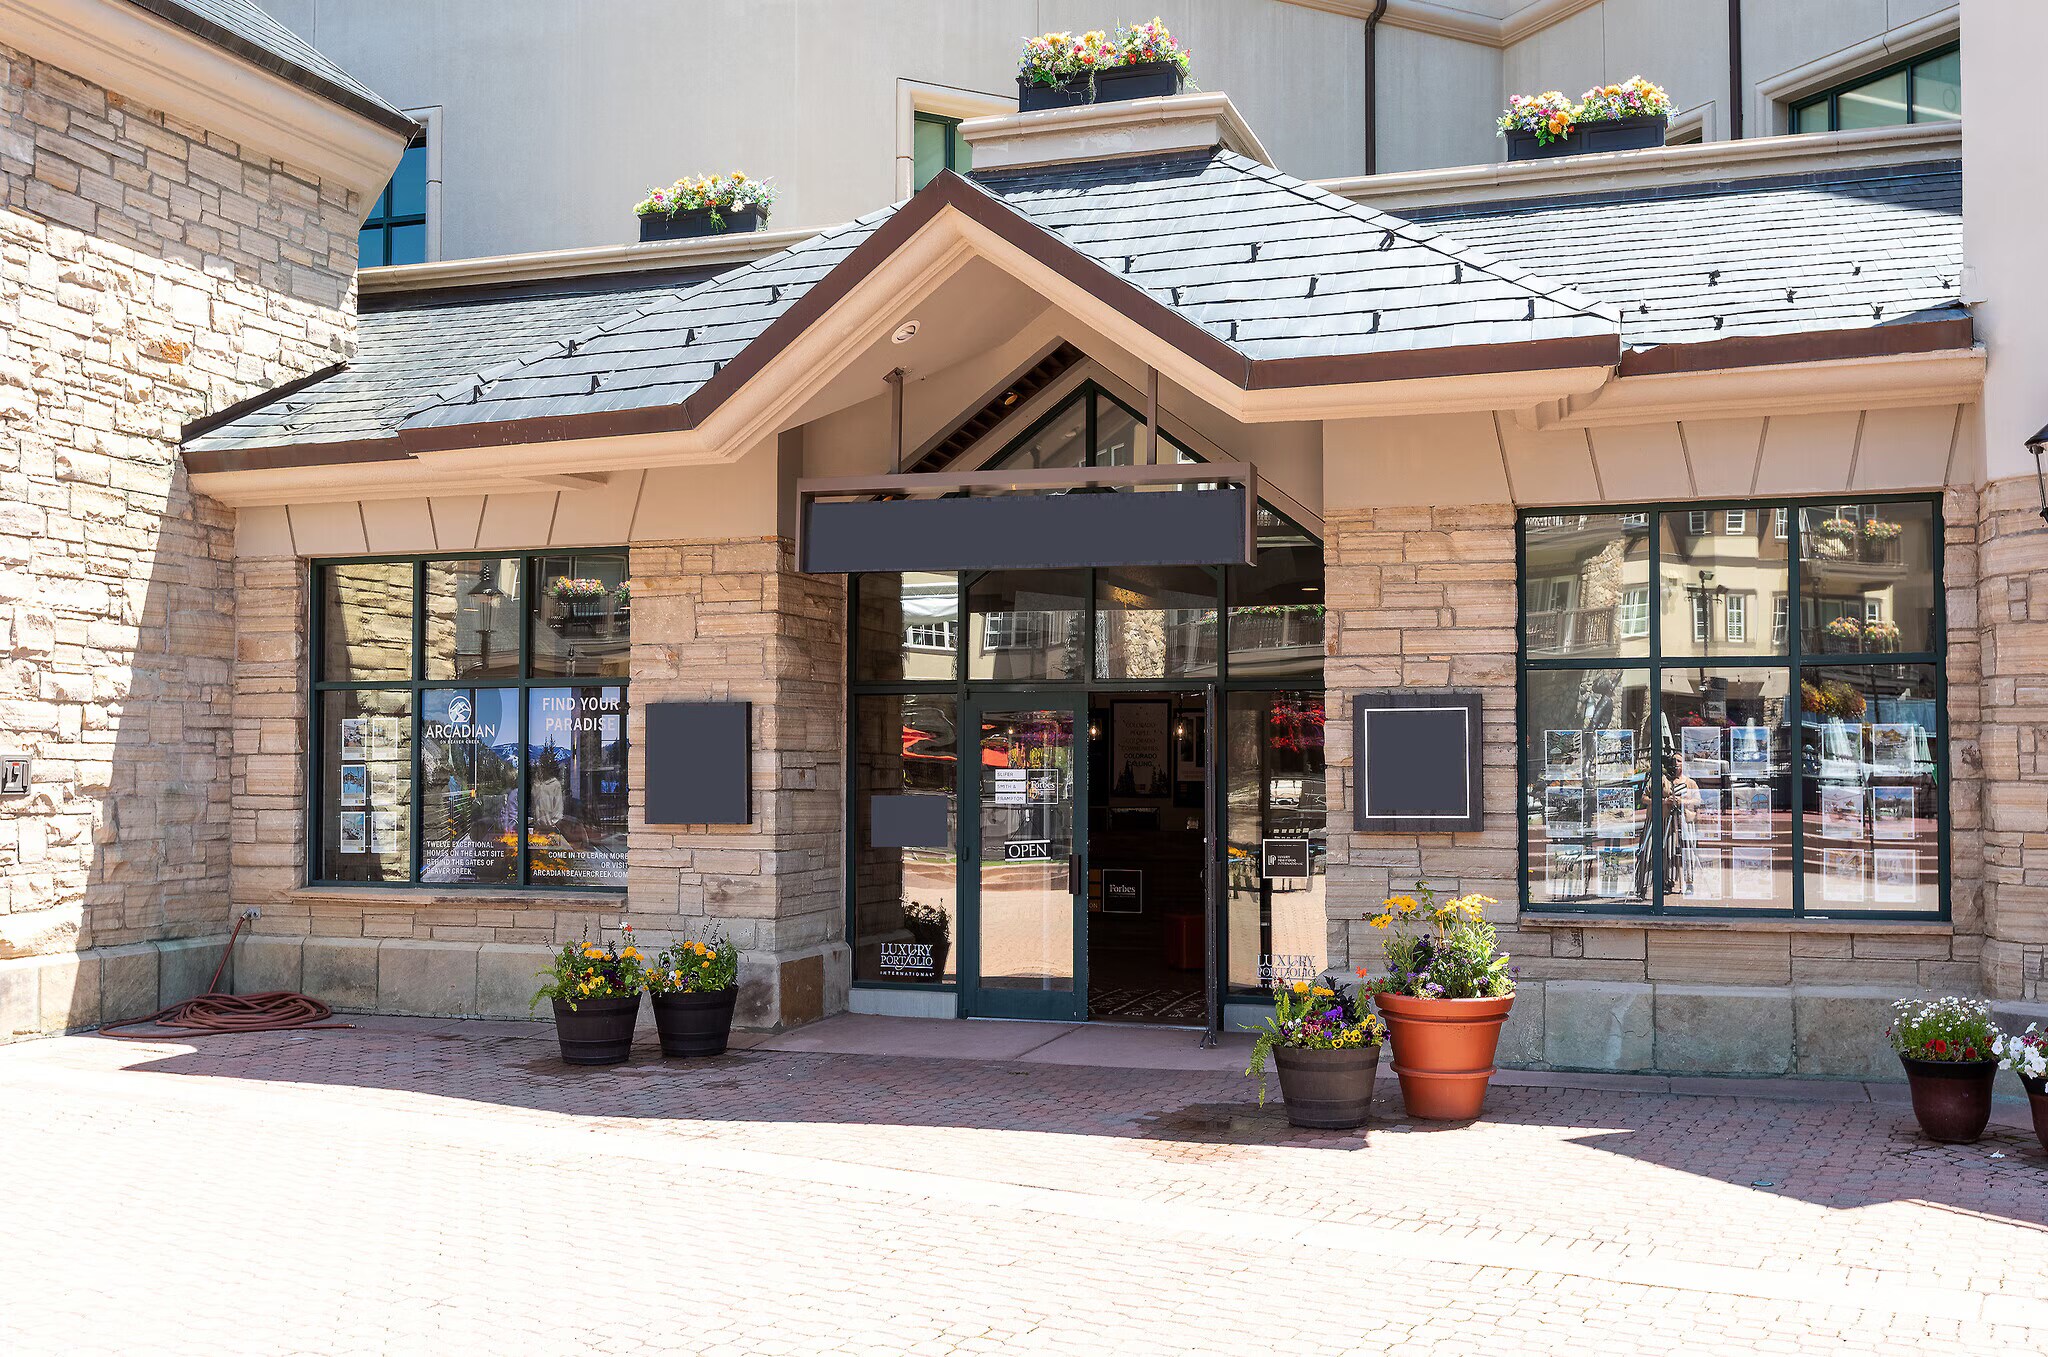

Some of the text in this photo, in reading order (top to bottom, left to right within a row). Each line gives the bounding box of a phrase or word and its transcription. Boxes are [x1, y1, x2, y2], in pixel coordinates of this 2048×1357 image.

[543, 697, 619, 711] FIND YOUR
[545, 717, 616, 731] PARADISE
[425, 724, 496, 738] ARCADIAN
[452, 840, 494, 848] EXCEPTIONAL
[474, 850, 489, 858] LAST
[491, 850, 505, 858] SITE
[548, 851, 567, 859] COME
[1008, 843, 1047, 858] OPEN
[486, 859, 495, 867] OF
[427, 867, 450, 875] BEAVER
[1109, 884, 1136, 893] Forbes
[880, 943, 934, 956] LUXURY
[880, 955, 934, 967] PORTFOLIO
